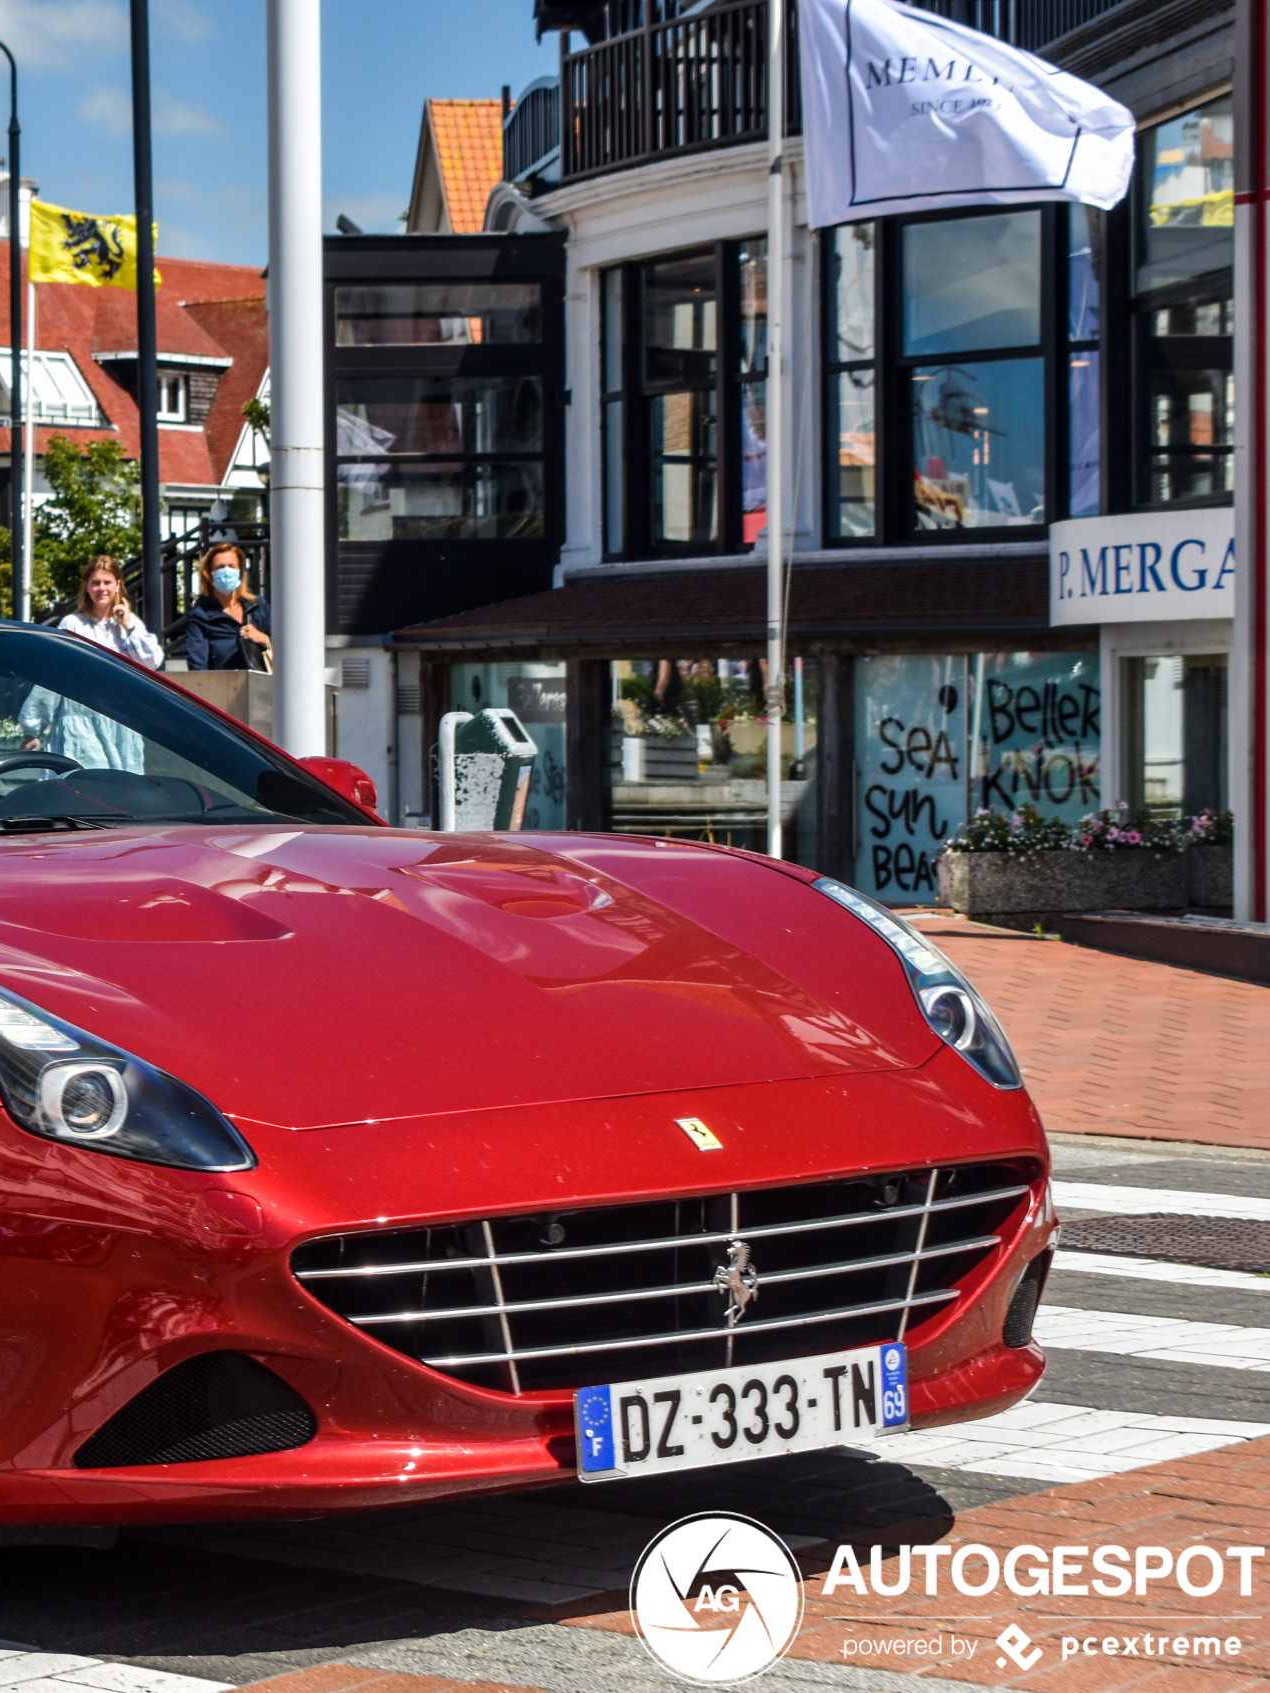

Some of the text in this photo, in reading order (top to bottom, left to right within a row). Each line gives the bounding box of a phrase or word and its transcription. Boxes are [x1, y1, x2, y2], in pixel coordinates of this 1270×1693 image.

[911, 99, 962, 117] SINCE
[872, 843, 939, 893] BeA
[619, 1360, 877, 1464] DZ-333-TN
[883, 1387, 906, 1420] 69
[592, 1437, 604, 1457] F
